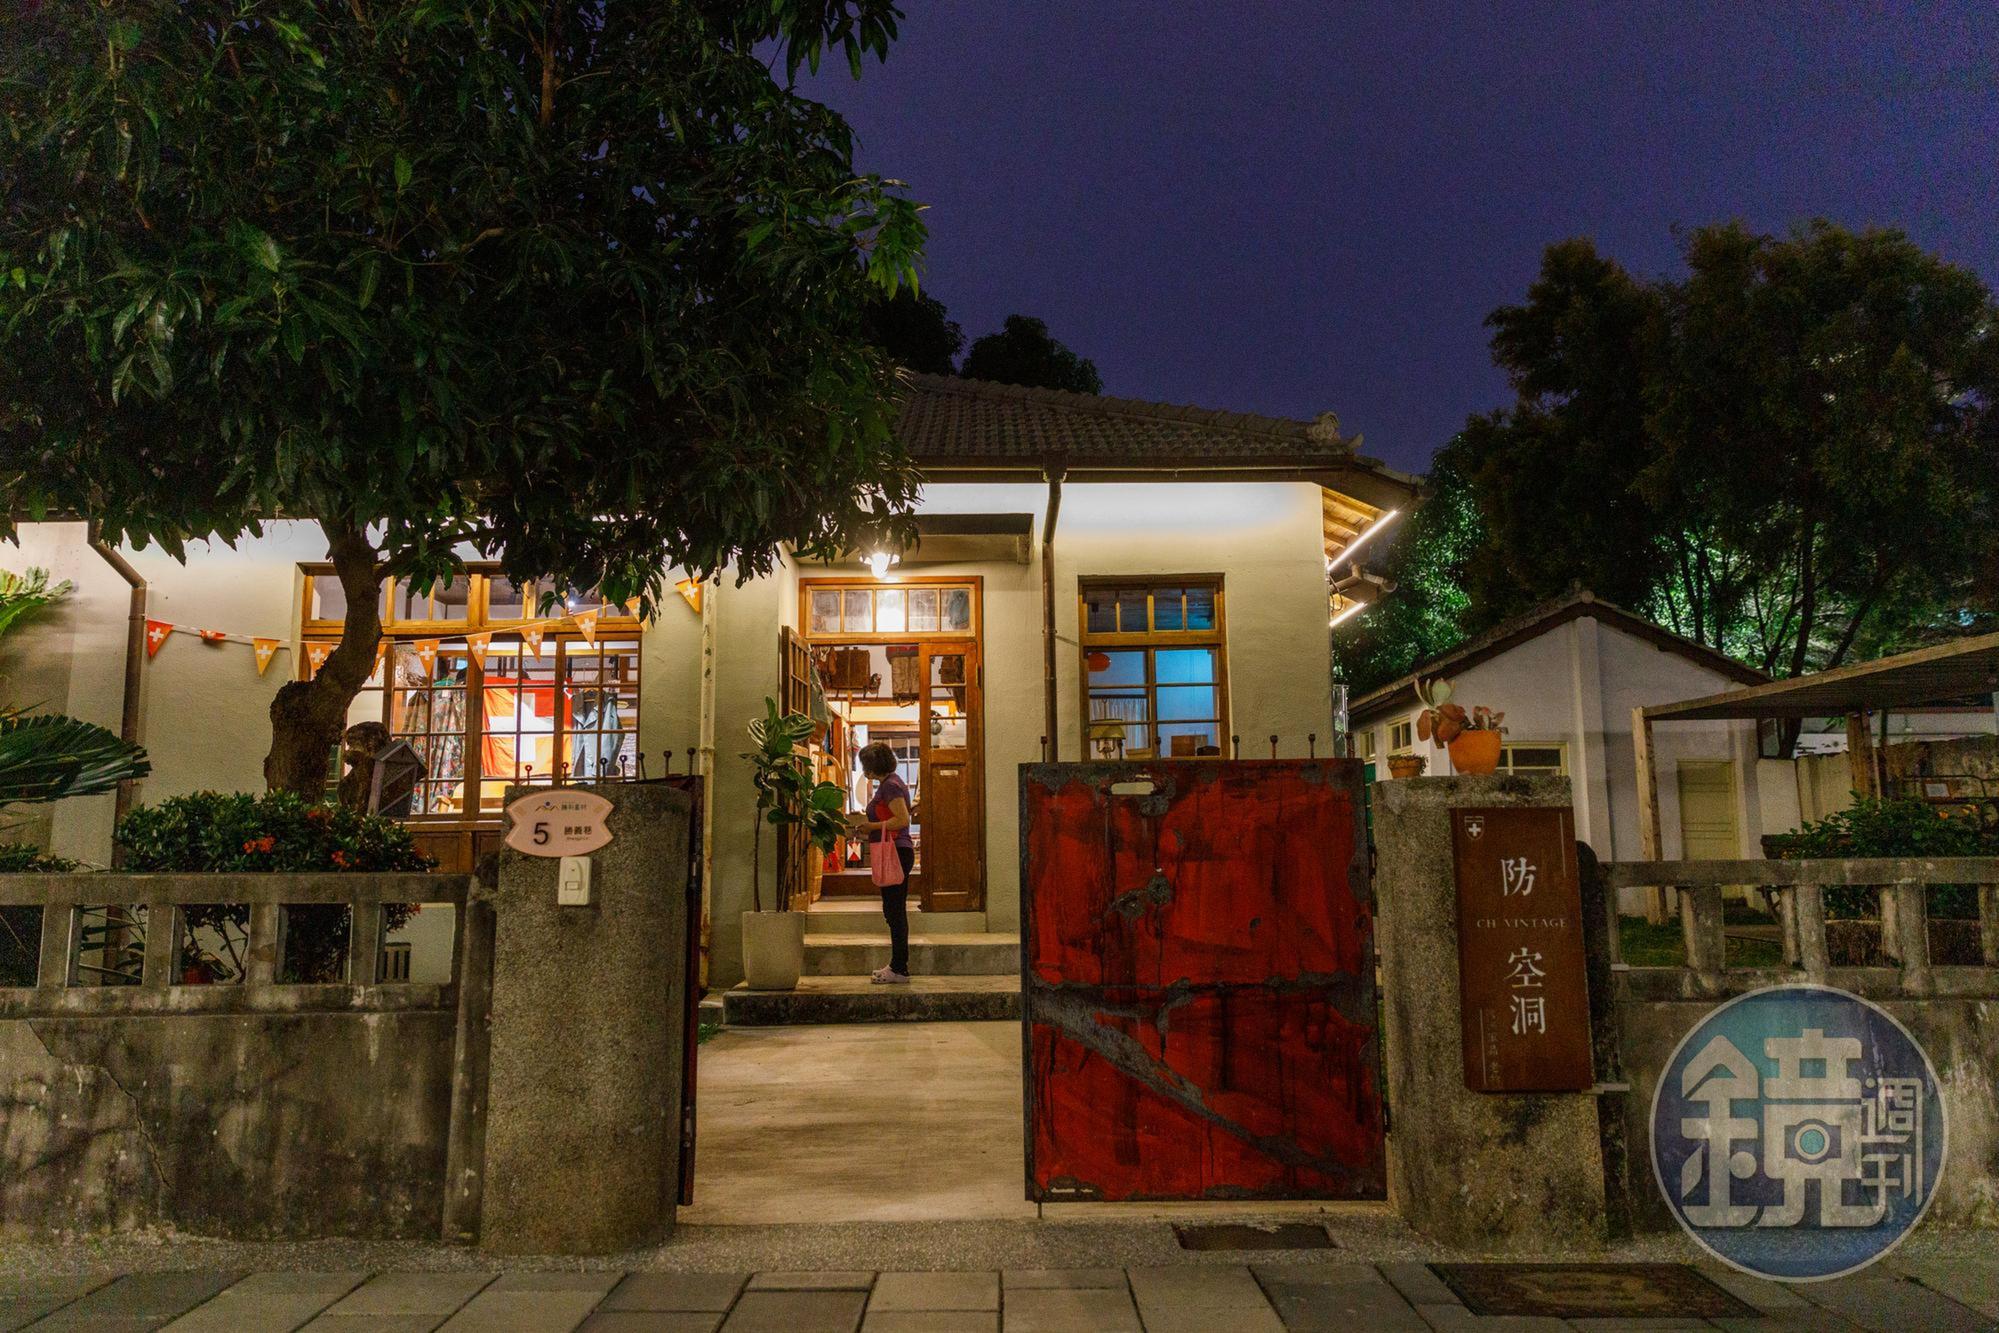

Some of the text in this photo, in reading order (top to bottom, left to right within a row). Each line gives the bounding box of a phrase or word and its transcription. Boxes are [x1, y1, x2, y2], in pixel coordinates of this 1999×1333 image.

[533, 822, 549, 845] 5
[1476, 918, 1568, 929] CH VINTAGE
